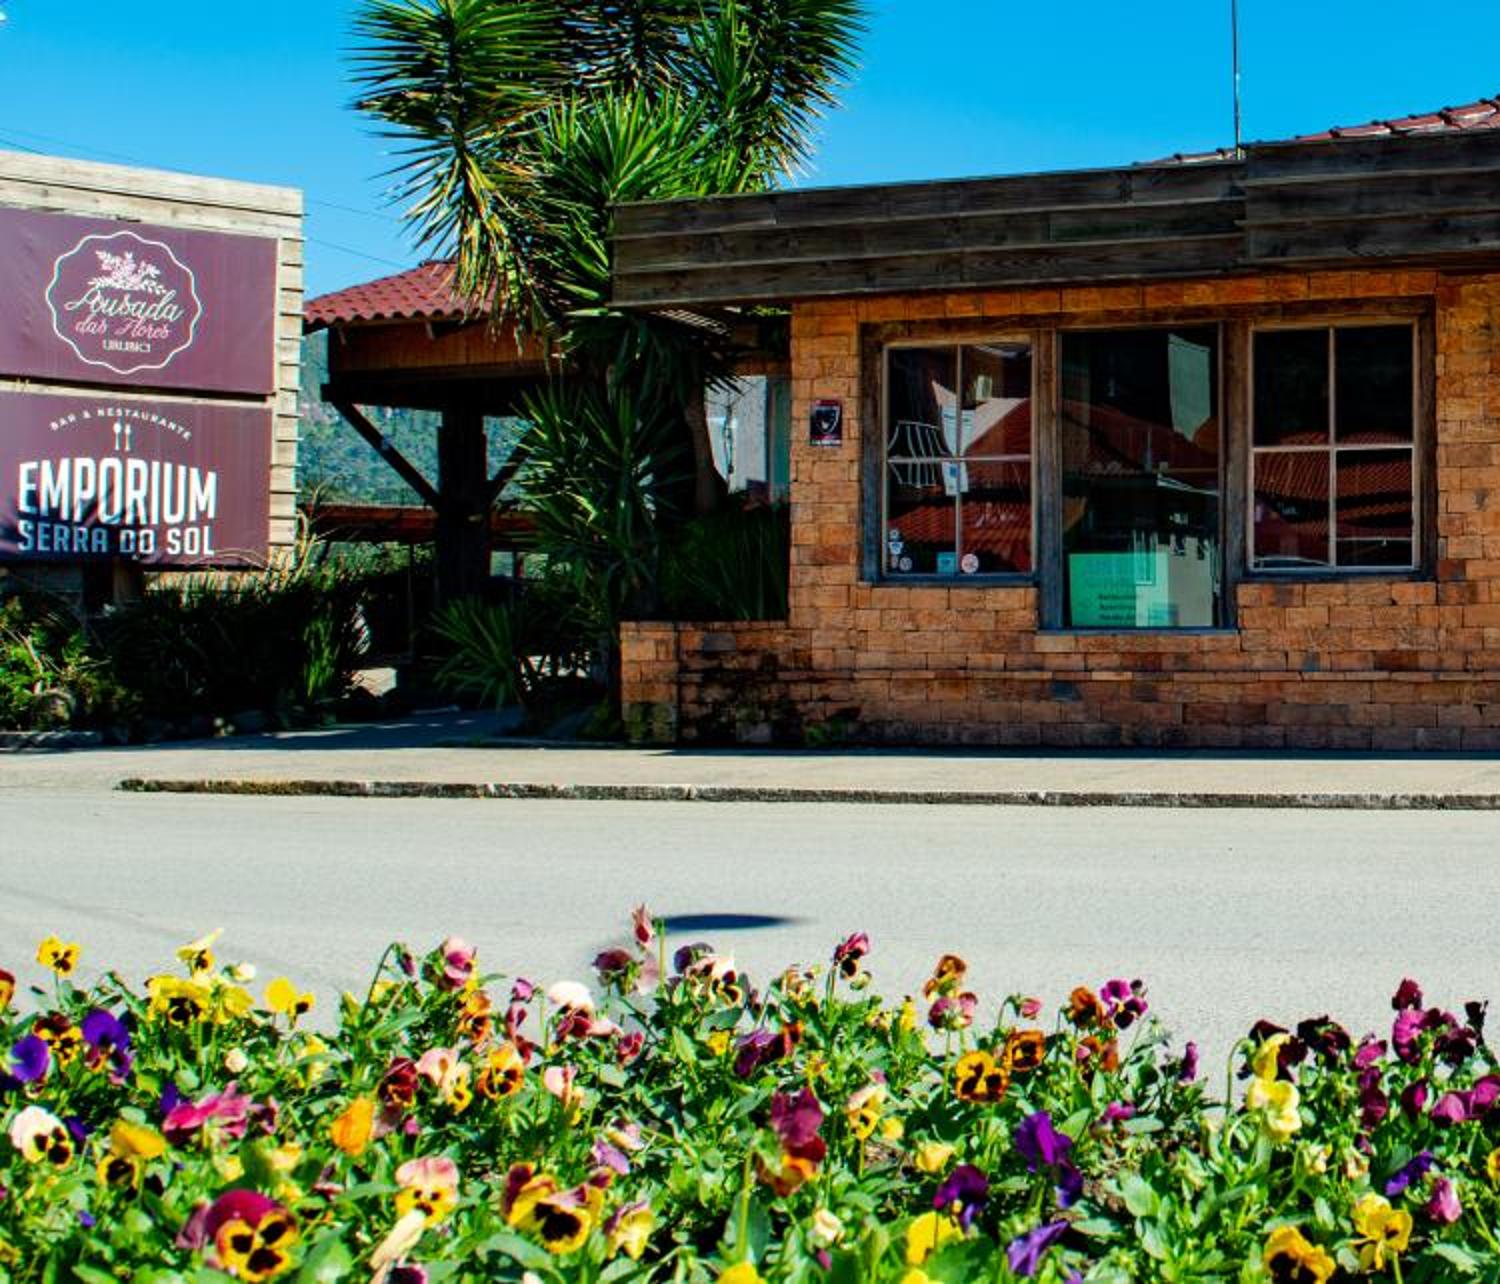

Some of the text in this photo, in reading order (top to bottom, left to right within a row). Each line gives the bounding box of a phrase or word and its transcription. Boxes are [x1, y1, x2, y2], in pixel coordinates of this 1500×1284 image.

[75, 315, 170, 340] das Flores
[50, 408, 192, 441] BAR & RESTAURANTE
[18, 457, 217, 525] EMPORIUM
[18, 520, 215, 556] SERRA DO SOL
